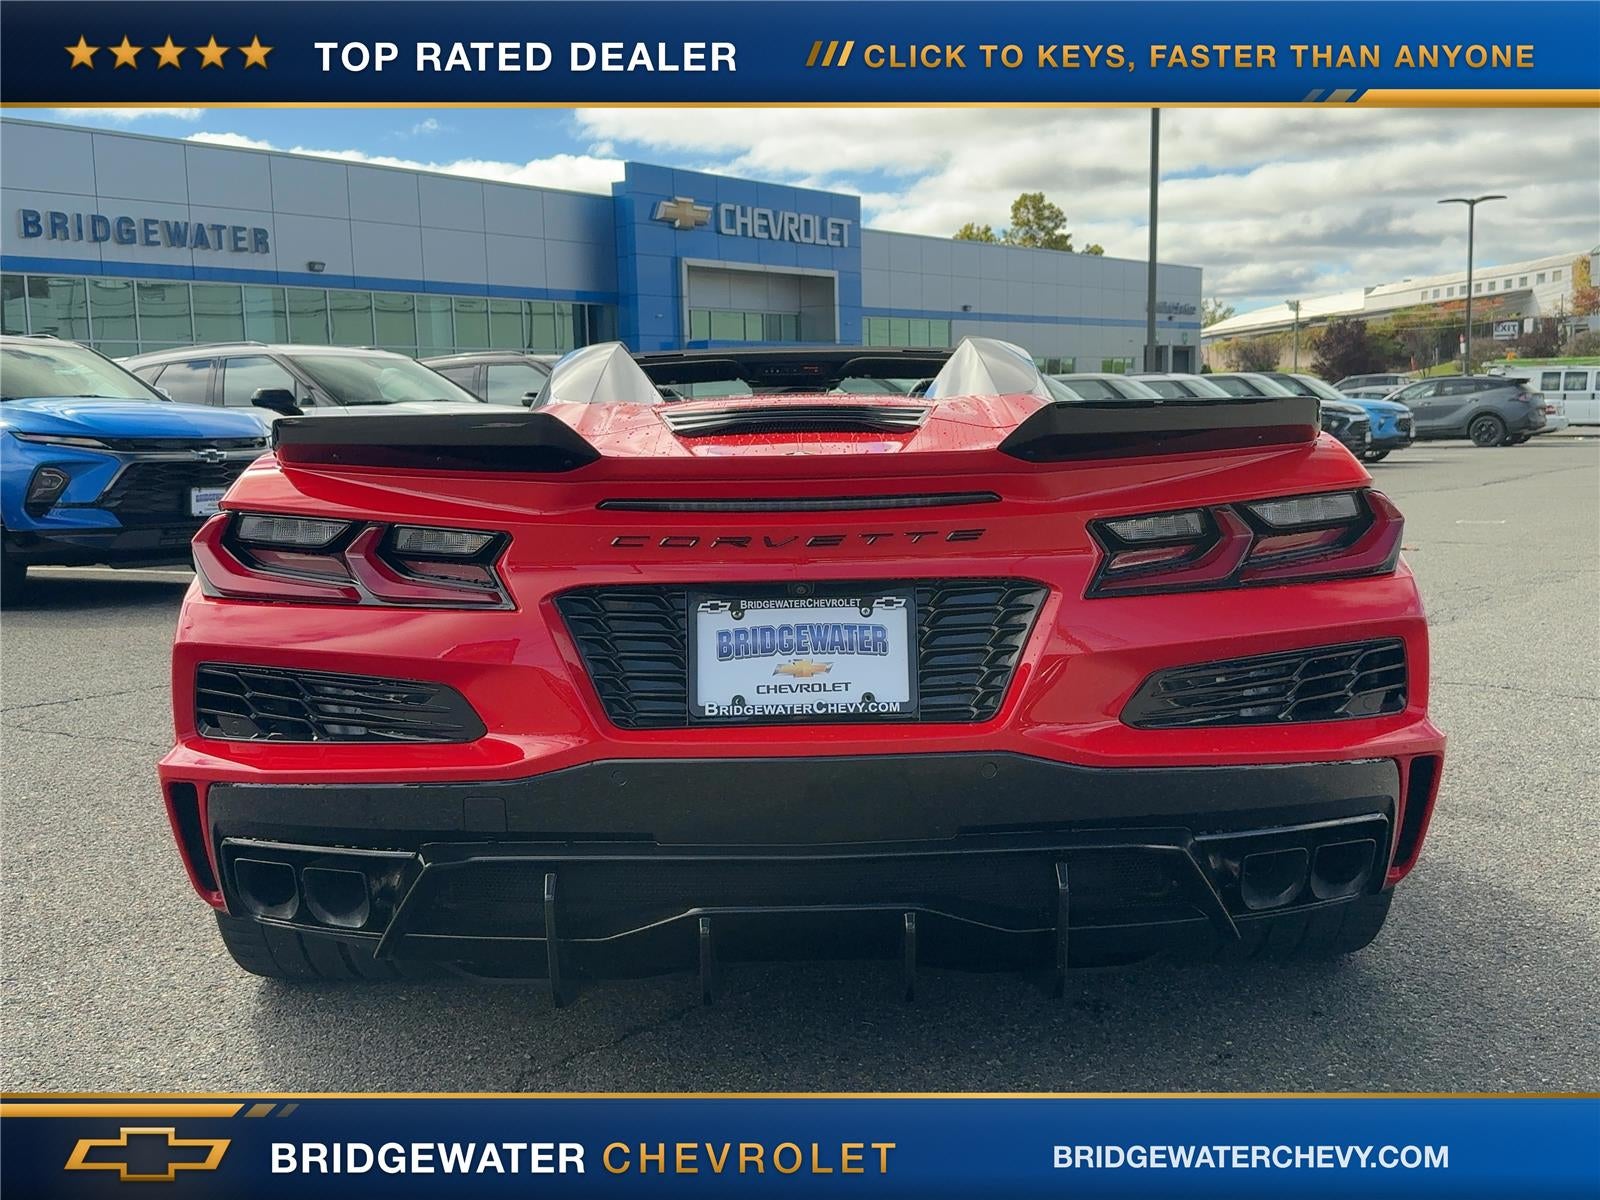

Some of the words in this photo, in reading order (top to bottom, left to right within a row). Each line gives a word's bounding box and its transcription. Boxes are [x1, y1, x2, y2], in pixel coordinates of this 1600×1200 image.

[18, 208, 270, 254] BRIDGEWATER
[718, 202, 852, 247] CHEVROLET
[1495, 323, 1517, 333] EXIT
[610, 528, 987, 549] CORVETTE
[716, 622, 889, 661] BRIDGEWATER
[756, 682, 852, 695] CHEVROLET
